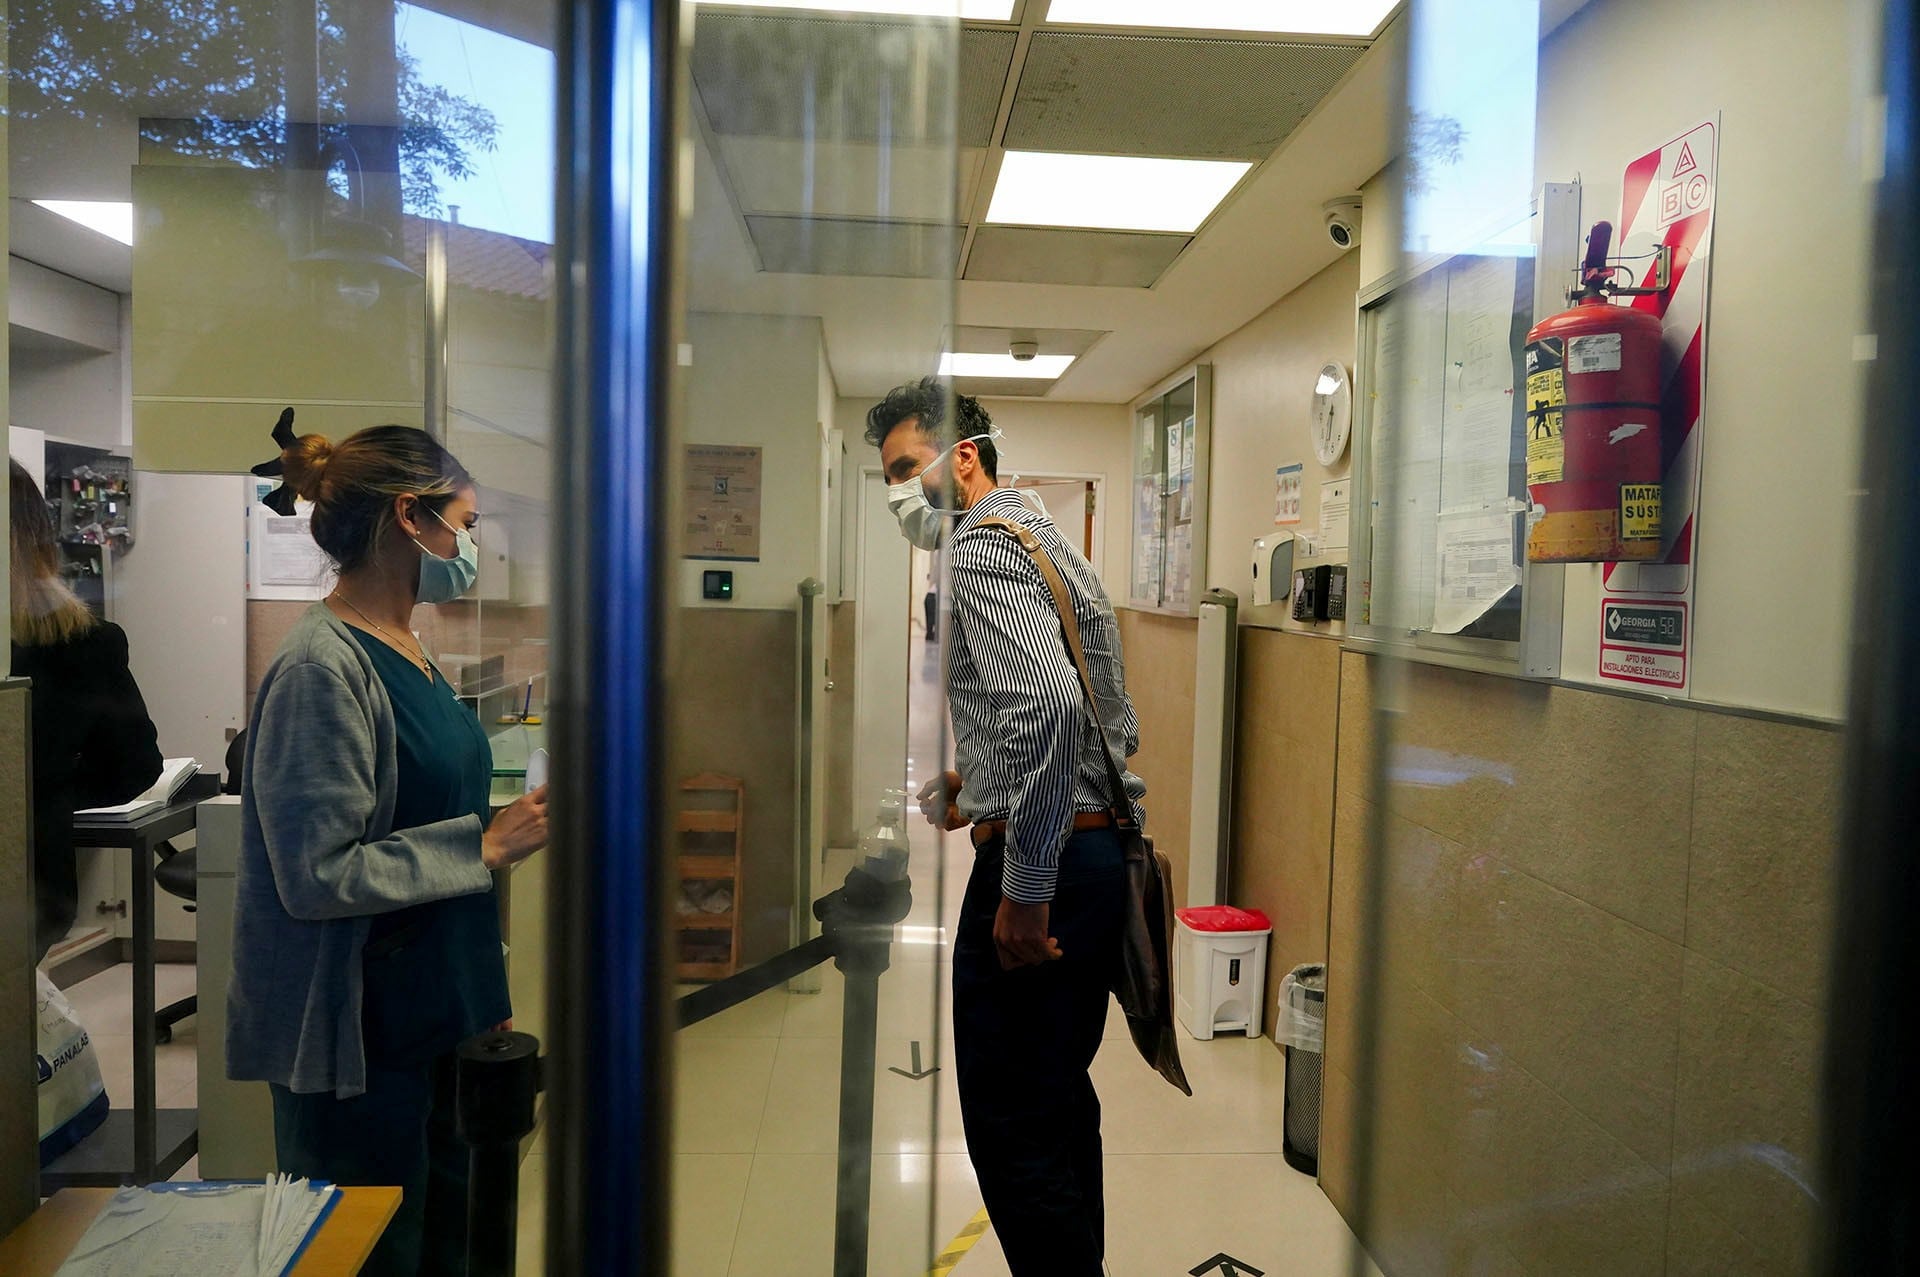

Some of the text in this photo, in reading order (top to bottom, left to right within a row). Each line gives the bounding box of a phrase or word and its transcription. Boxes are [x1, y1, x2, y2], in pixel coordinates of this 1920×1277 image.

[1679, 154, 1691, 170] A
[1666, 182, 1702, 212] B C
[1621, 616, 1657, 628] GEORGIA
[1625, 654, 1656, 665] APTO PARA
[1603, 662, 1681, 680] INSTALACIONES ELECTRICAS
